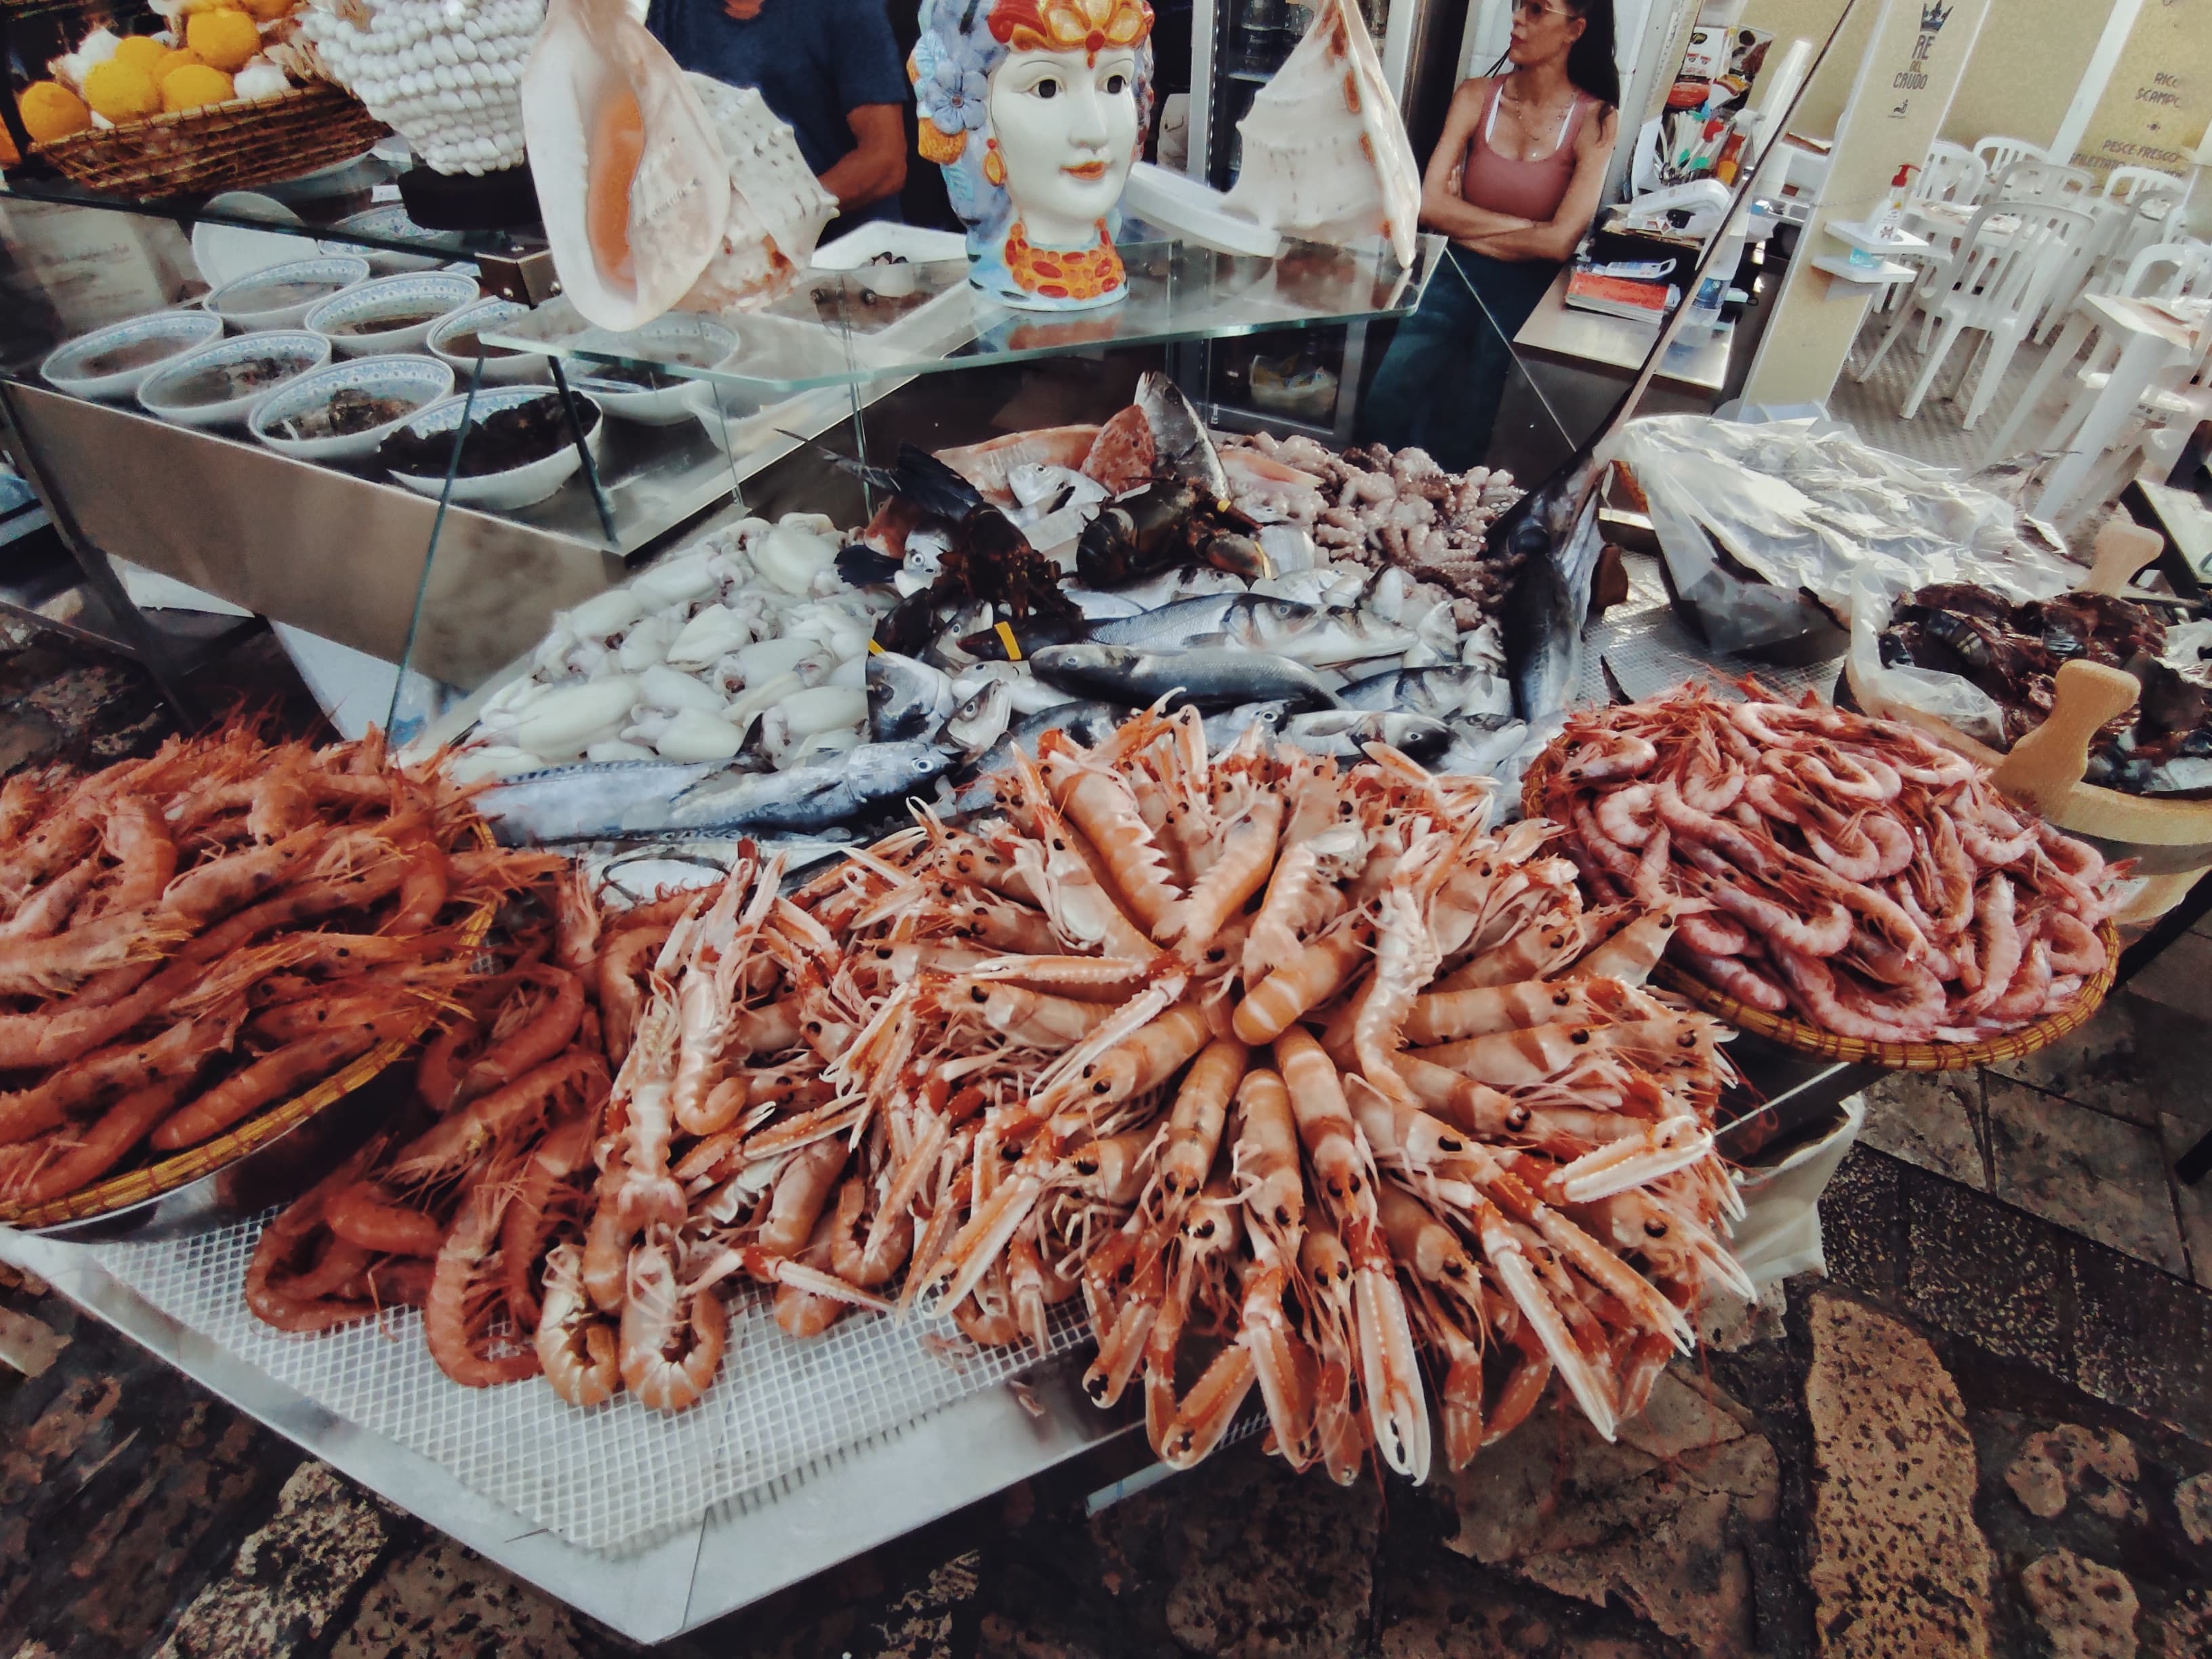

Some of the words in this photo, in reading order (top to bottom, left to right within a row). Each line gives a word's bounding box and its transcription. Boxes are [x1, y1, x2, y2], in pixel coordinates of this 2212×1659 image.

[1911, 35, 1936, 60] RE
[1893, 72, 1928, 89] CRUDO
[2102, 139, 2136, 155] PESCE
[2136, 146, 2178, 163] FRESCO
